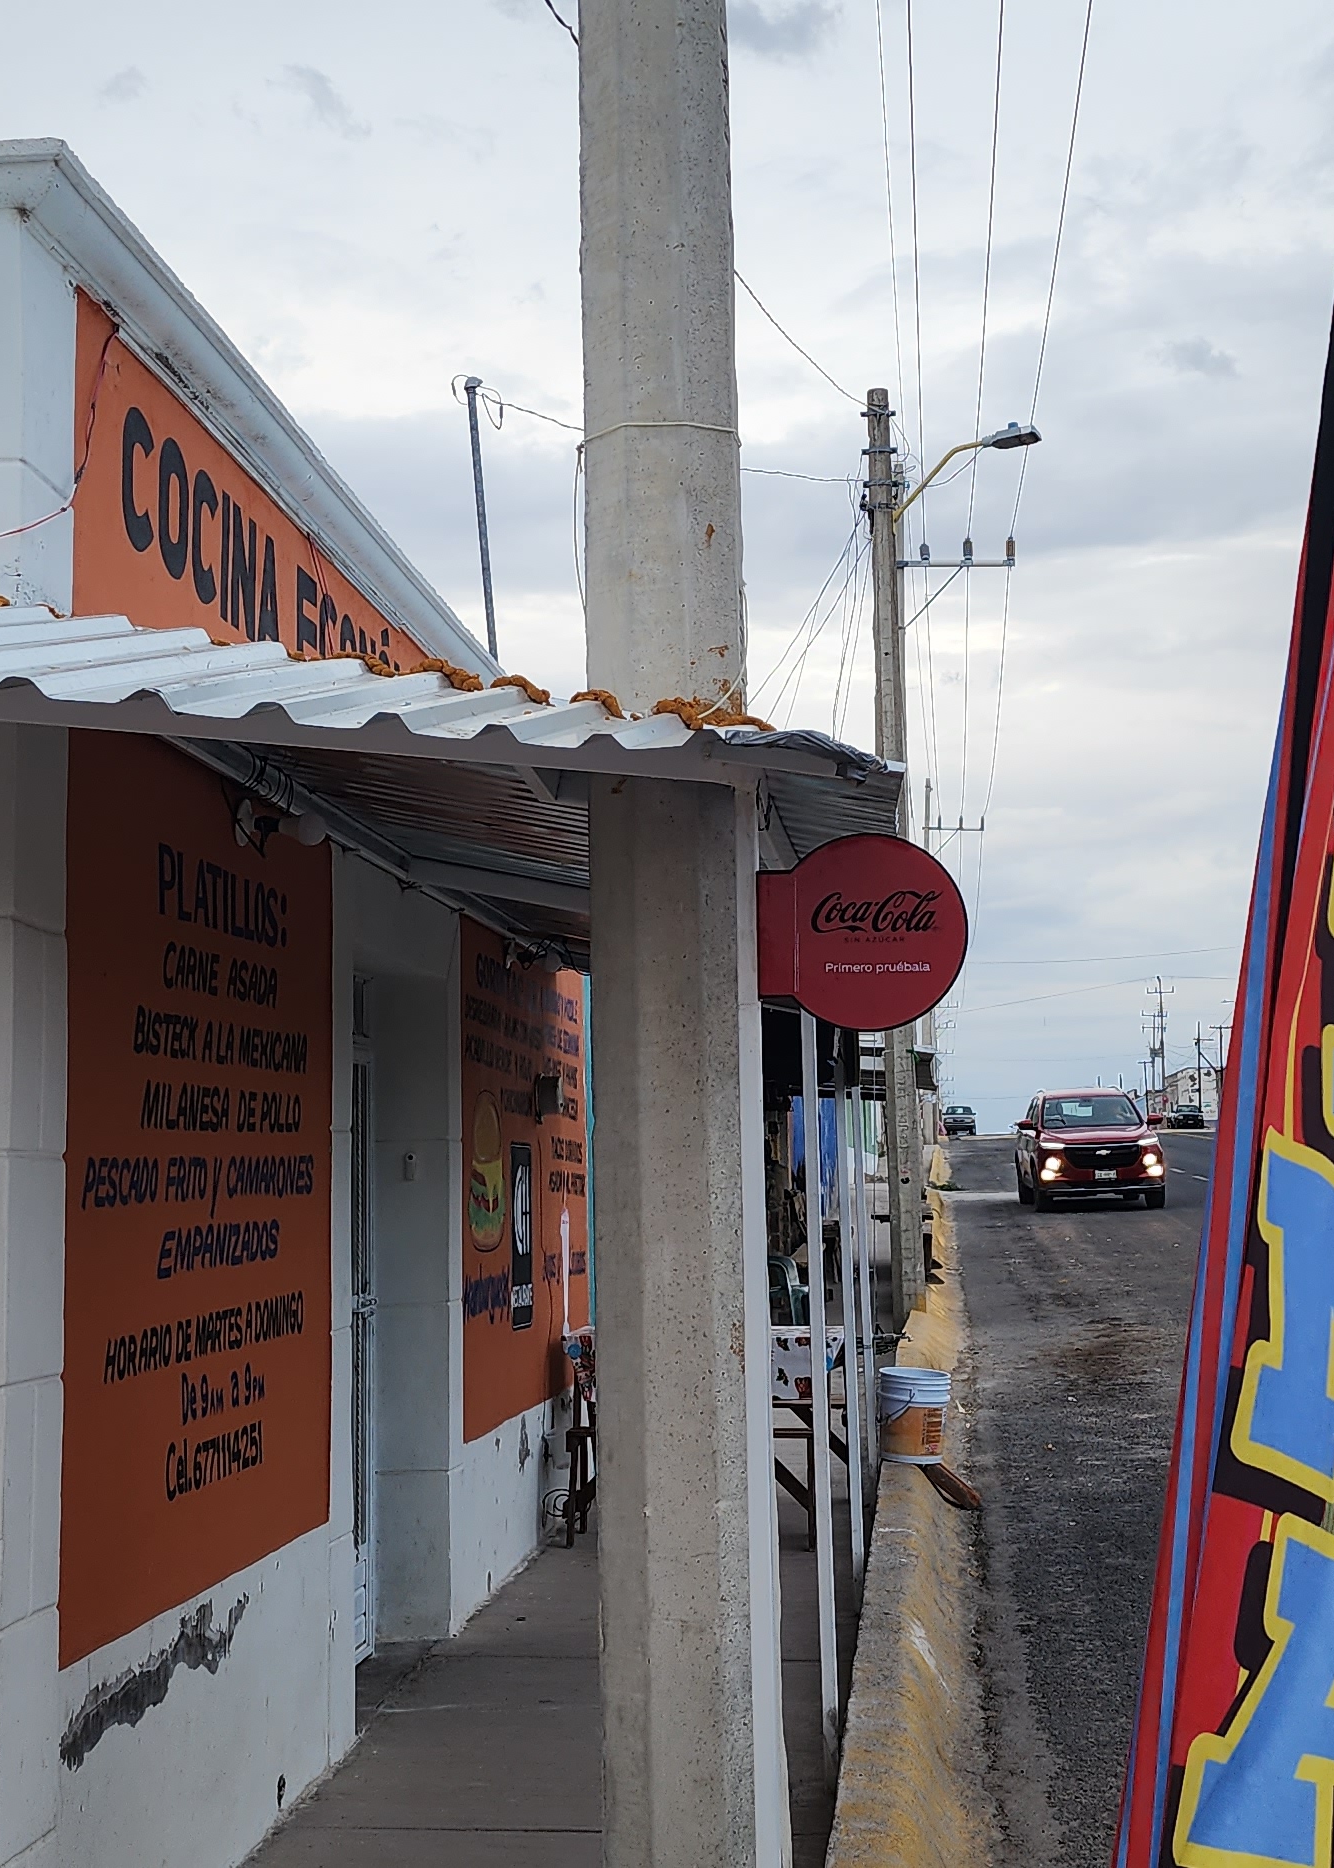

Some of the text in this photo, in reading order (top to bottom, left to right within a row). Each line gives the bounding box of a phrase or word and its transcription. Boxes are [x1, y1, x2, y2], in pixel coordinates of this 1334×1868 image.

[122, 407, 280, 642] COCINA
[158, 841, 288, 948] PLATILLOS:
[811, 890, 943, 933] Coca-Cola
[163, 940, 278, 1009] CARNE ASADA
[825, 960, 931, 975] Primero pruébala
[133, 1004, 199, 1061] BISTECK
[238, 1027, 308, 1075] MEXICANA
[140, 1079, 302, 1134] MILANESA DE POLLO
[81, 1156, 159, 1211] PESCADO
[164, 1155, 208, 1203] FRITO
[226, 1154, 314, 1199] CAMARONES
[156, 1218, 280, 1280] EMPANIZADOS
[103, 1320, 172, 1385] HORARIO
[175, 1316, 192, 1364] DE
[194, 1305, 243, 1360] MARTES
[254, 1290, 304, 1343] DOMINGO
[180, 1371, 197, 1426] De
